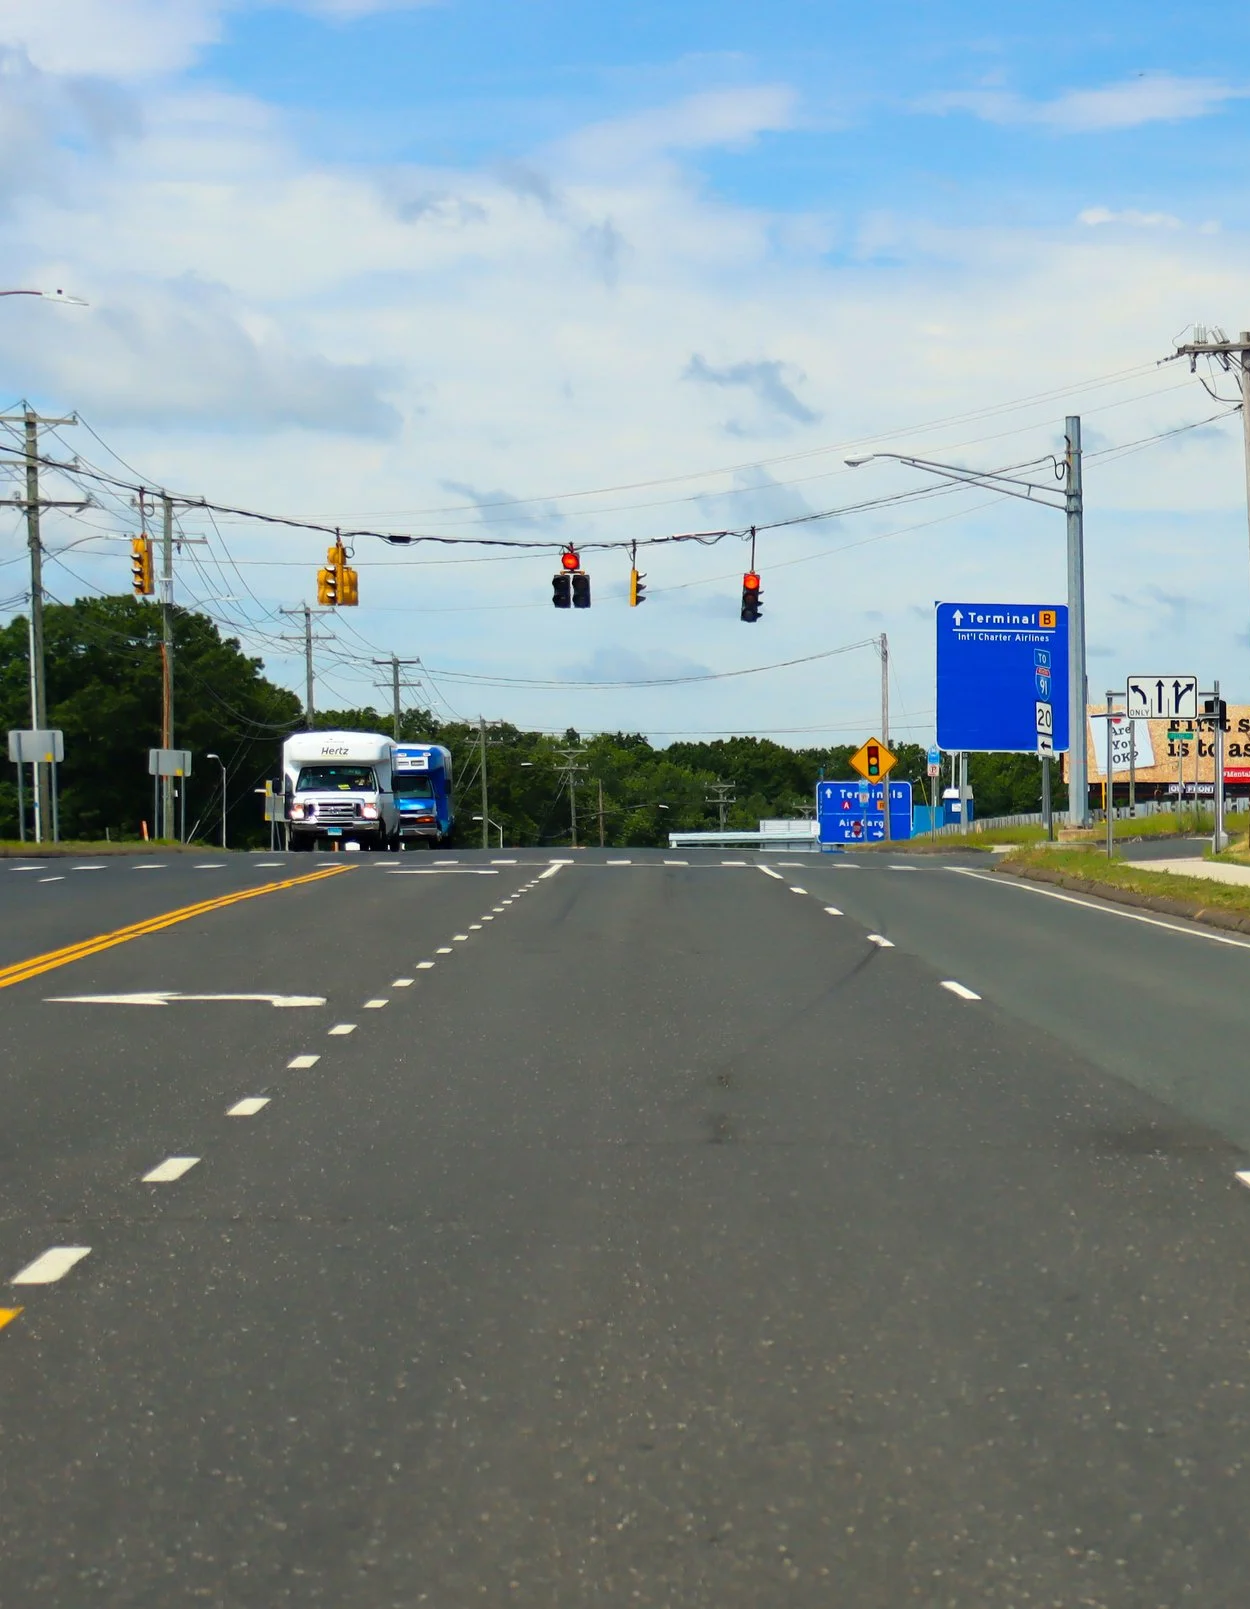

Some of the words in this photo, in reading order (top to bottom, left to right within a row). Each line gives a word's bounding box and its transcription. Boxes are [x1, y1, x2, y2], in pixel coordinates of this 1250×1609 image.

[968, 612, 1035, 624] Terminal
[1044, 613, 1051, 624] B
[958, 633, 976, 641] Int'l
[979, 633, 1011, 641] Charter
[1015, 634, 1050, 642] Airlines
[1038, 653, 1047, 664] TO
[1040, 679, 1047, 695] 91
[1038, 709, 1051, 727] 20
[1112, 740, 1136, 750] Yo
[1168, 739, 1189, 757] is
[321, 747, 349, 755] Hertz
[840, 789, 903, 799] Terinls
[860, 819, 884, 829] Carg
